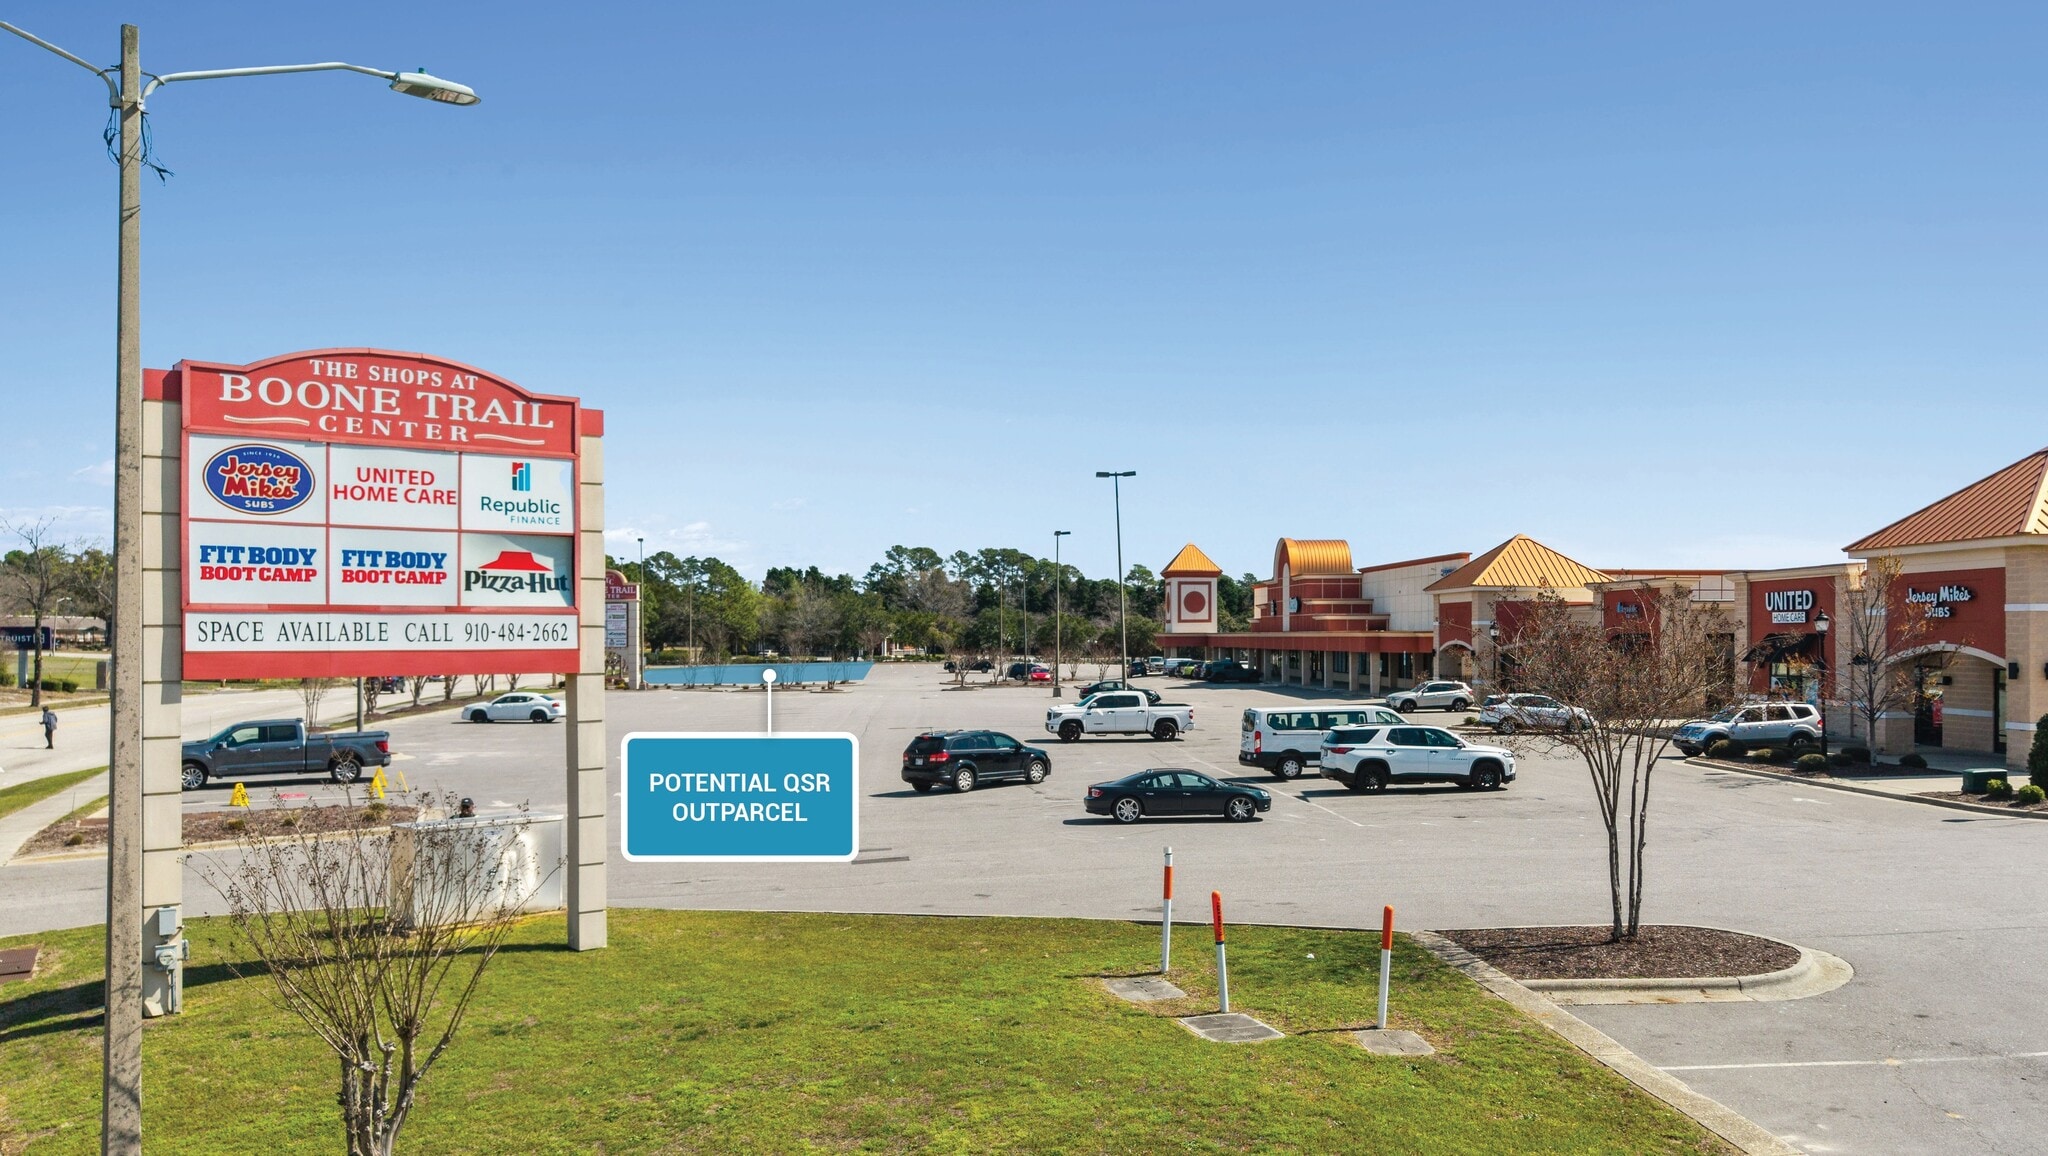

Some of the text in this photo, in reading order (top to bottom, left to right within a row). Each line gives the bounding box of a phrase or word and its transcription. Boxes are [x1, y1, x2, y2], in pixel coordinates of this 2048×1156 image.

[309, 359, 479, 390] THE SHOPS AT
[219, 373, 554, 428] BOONE TRAIL
[318, 415, 469, 442] CENTER
[219, 455, 300, 484] Jersey
[357, 467, 435, 486] UNITED
[223, 475, 299, 499] Mike's
[333, 484, 457, 505] HOME CARE
[245, 500, 275, 509] SUBS
[481, 496, 560, 516] Republic
[510, 515, 560, 525] FINANCE
[200, 545, 317, 566] FIT BODY
[342, 549, 447, 570] FIT BODY
[200, 566, 317, 582] BOOT CAMP
[342, 569, 447, 585] BOOT CAMP
[464, 570, 571, 593] Pizza Hut
[610, 586, 636, 594] TRAIL
[1765, 590, 1813, 611] UNITED
[1905, 585, 1971, 607] Jersey Mike's
[1773, 612, 1805, 622] HOME CARE
[1925, 606, 1951, 618] SUBS
[198, 620, 568, 643] SPACE AVAILABLE CALL 910-484-2662
